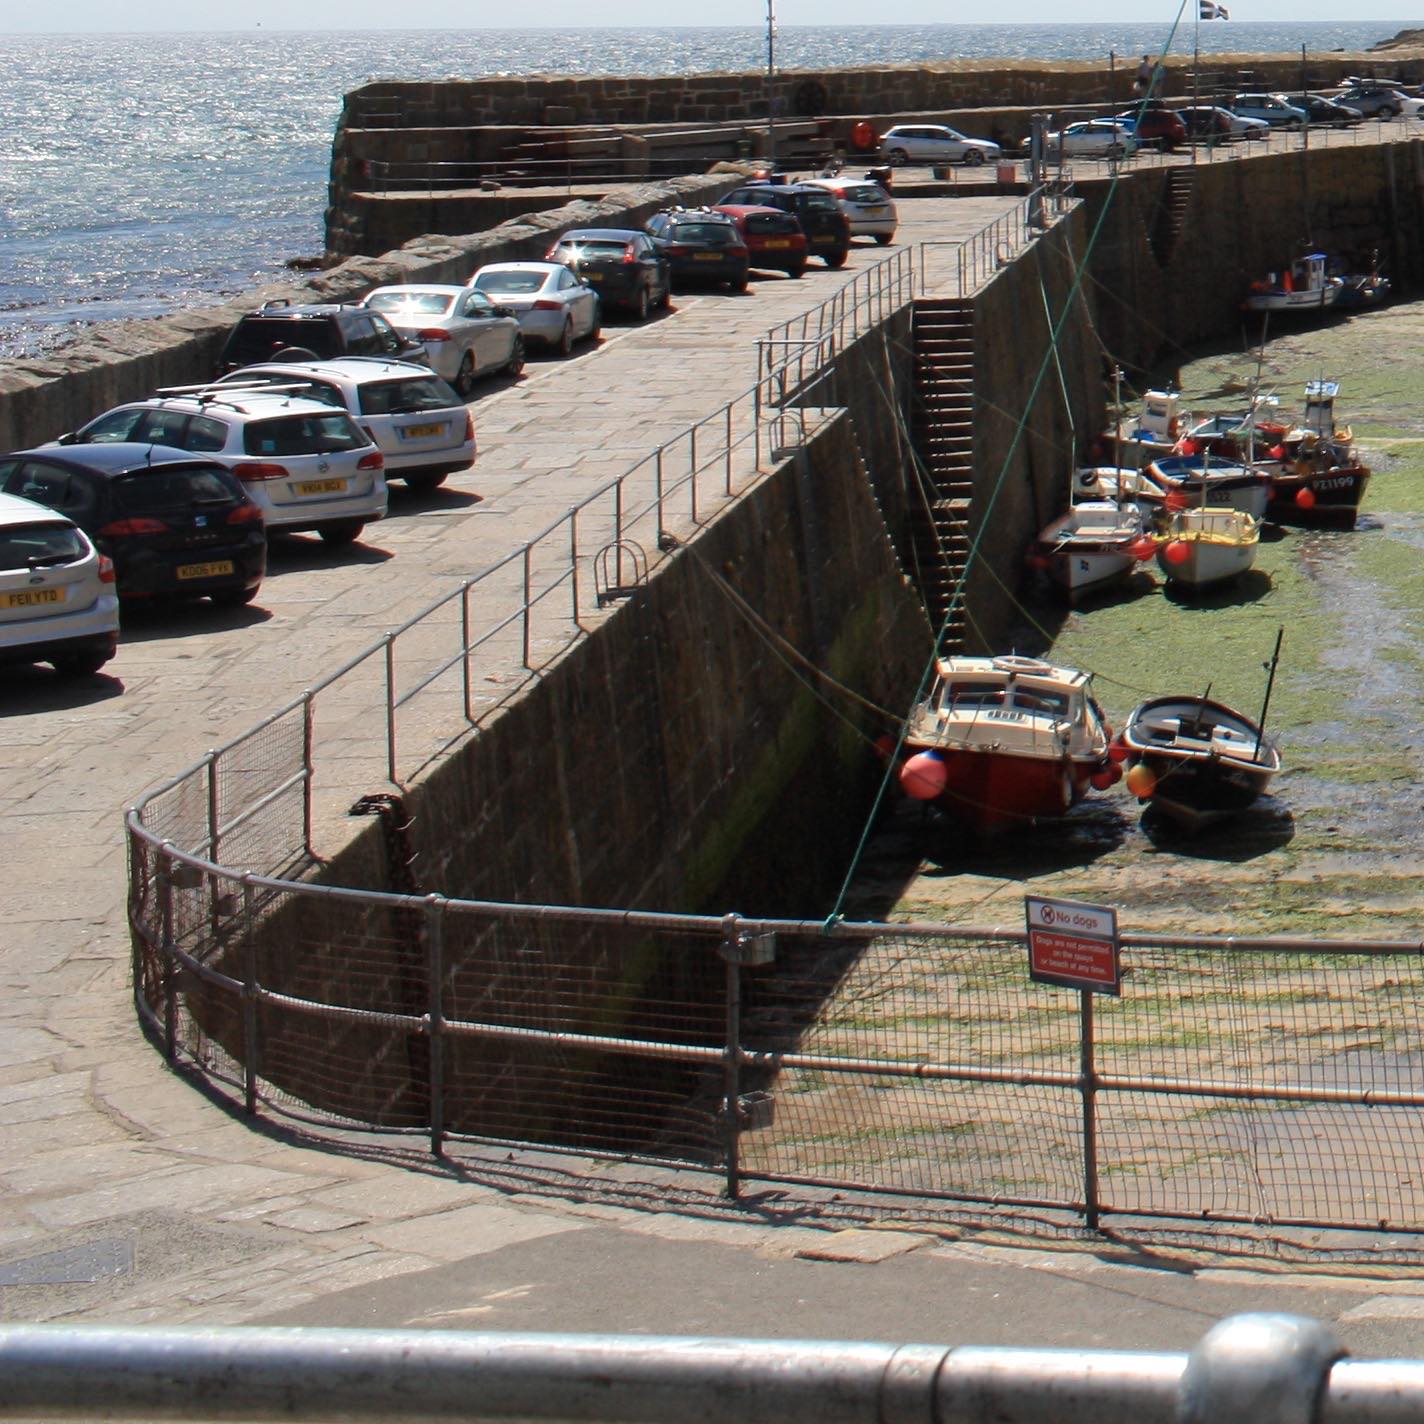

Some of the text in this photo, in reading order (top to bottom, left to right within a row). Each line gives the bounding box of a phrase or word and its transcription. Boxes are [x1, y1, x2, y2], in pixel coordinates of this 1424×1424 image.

[9, 590, 31, 607] FE11
[1056, 911, 1098, 929] No dogs
[1036, 936, 1053, 946] Dogs
[1066, 941, 1077, 949] not
[1078, 943, 1110, 955] permitted
[1049, 959, 1069, 968] beach
[1078, 964, 1089, 973] any
